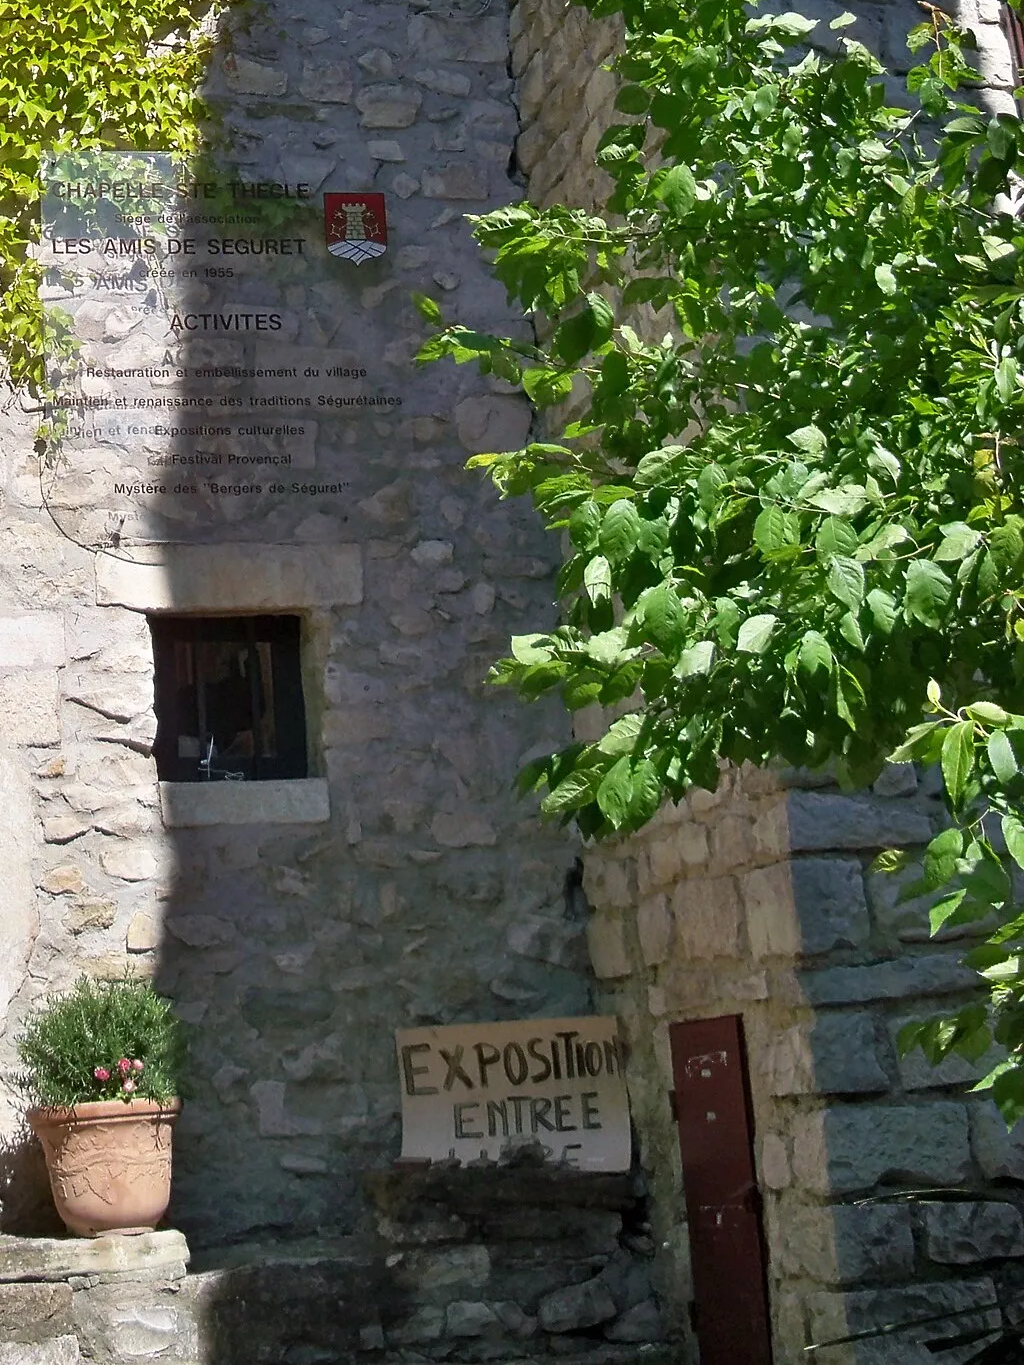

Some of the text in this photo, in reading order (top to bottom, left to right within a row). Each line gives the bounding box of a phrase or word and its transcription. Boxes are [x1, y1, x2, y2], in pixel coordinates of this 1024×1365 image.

[52, 182, 164, 199] CHAPELLE
[52, 239, 307, 255] LES AMIS DE SEGURET
[139, 267, 234, 278] créée en 1955
[170, 314, 282, 331] ACTIVITES
[86, 367, 367, 380] Restauration et embellissement du village
[53, 394, 403, 410] Maintien et renaissance des traditions Ségurétaines
[155, 424, 306, 437] Expositions culturelles
[172, 454, 292, 467] Festival Provençal
[114, 482, 168, 496] Mystère
[174, 482, 198, 494] des
[269, 482, 286, 494] de
[401, 1031, 626, 1095] EXPOSITION
[453, 1091, 602, 1139] ENTREE
